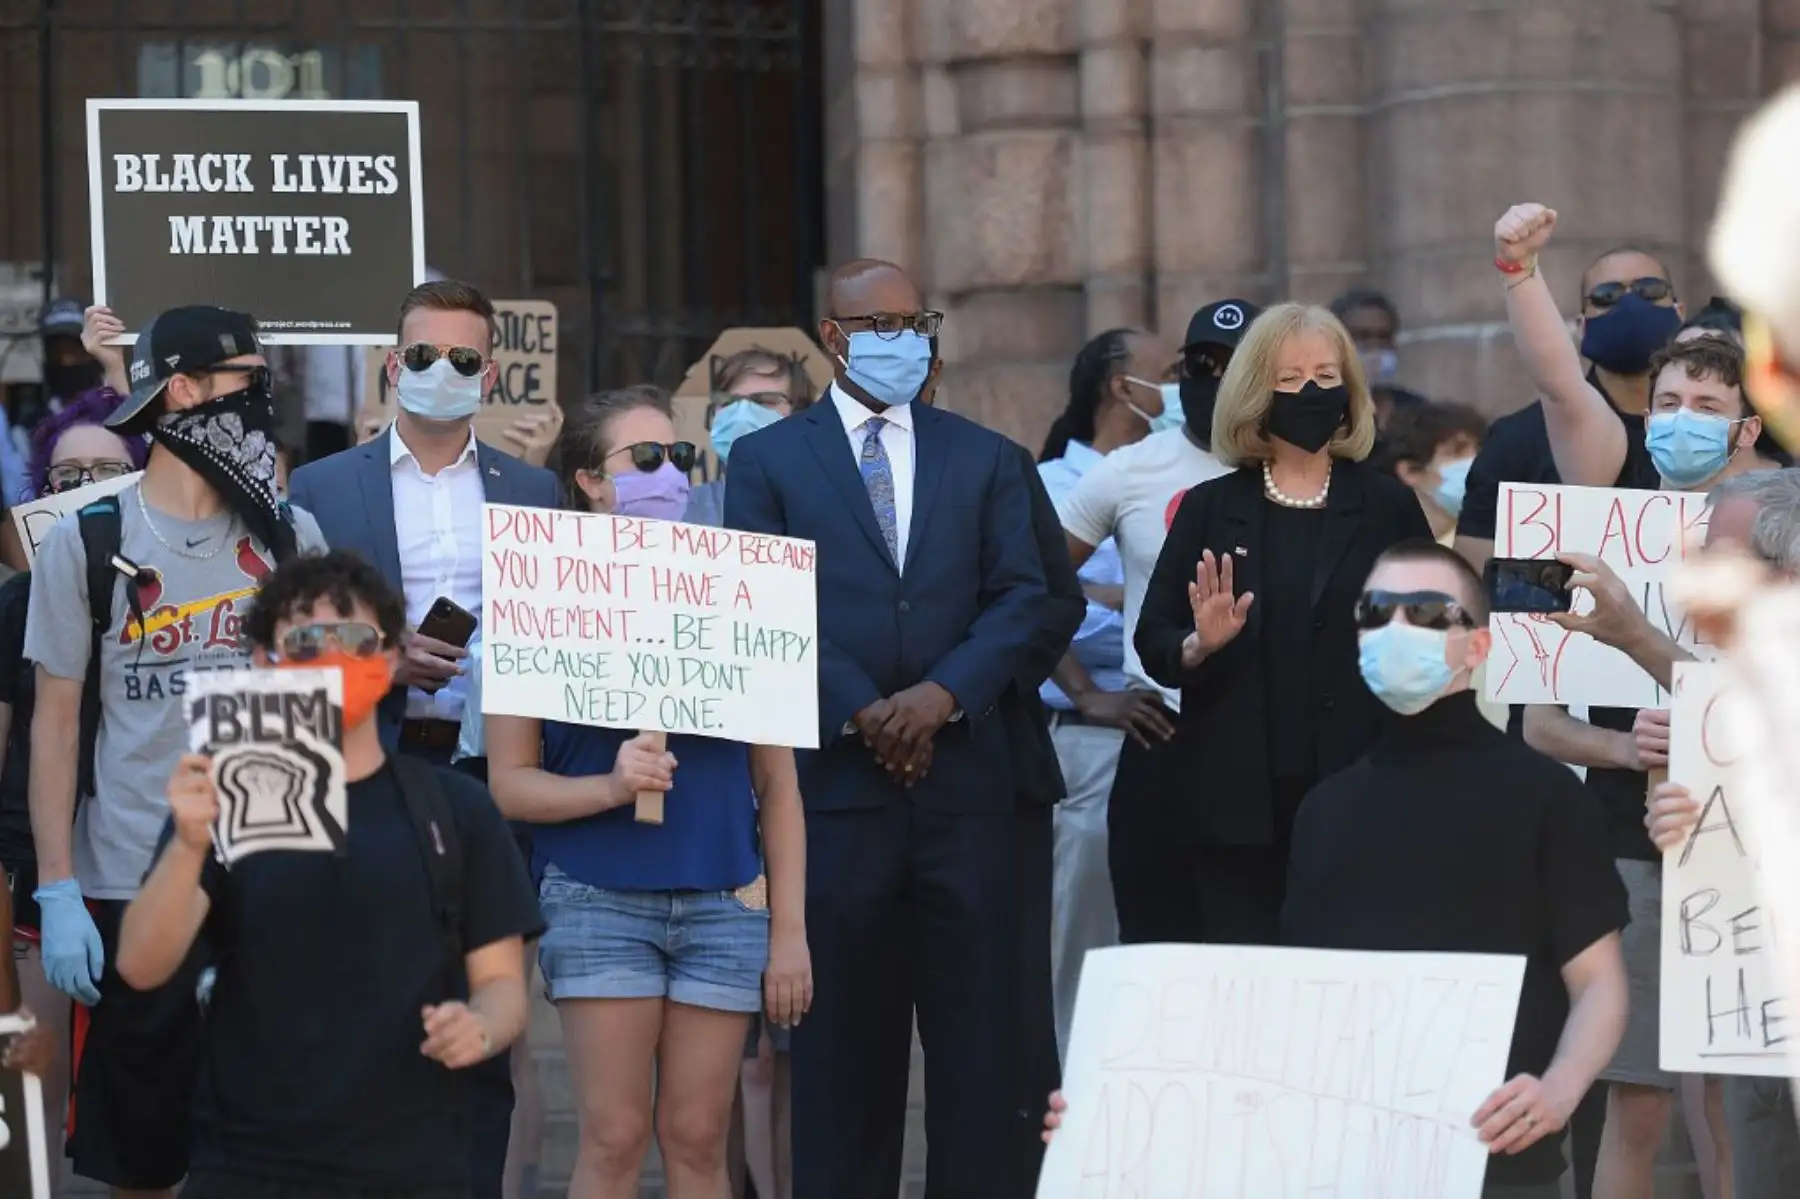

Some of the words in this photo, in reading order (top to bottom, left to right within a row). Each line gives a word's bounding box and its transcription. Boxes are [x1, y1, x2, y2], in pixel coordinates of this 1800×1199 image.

[192, 48, 331, 98] 101
[113, 154, 254, 193] BLACK
[270, 154, 399, 195] LIVES
[168, 216, 351, 255] MATTER
[488, 508, 595, 547] DON'T
[611, 516, 658, 553] BE
[671, 525, 731, 561] MAD
[491, 548, 538, 590] YOU
[555, 555, 640, 599] DON'T
[651, 565, 721, 606] HAVE
[734, 579, 753, 611] A
[673, 613, 721, 651] BE
[733, 620, 811, 662] HAPPY
[490, 643, 612, 679] BECAUSE
[627, 651, 670, 688] YOU
[206, 689, 336, 745] BLM
[564, 683, 647, 722] NEED
[658, 695, 725, 730] ONE.
